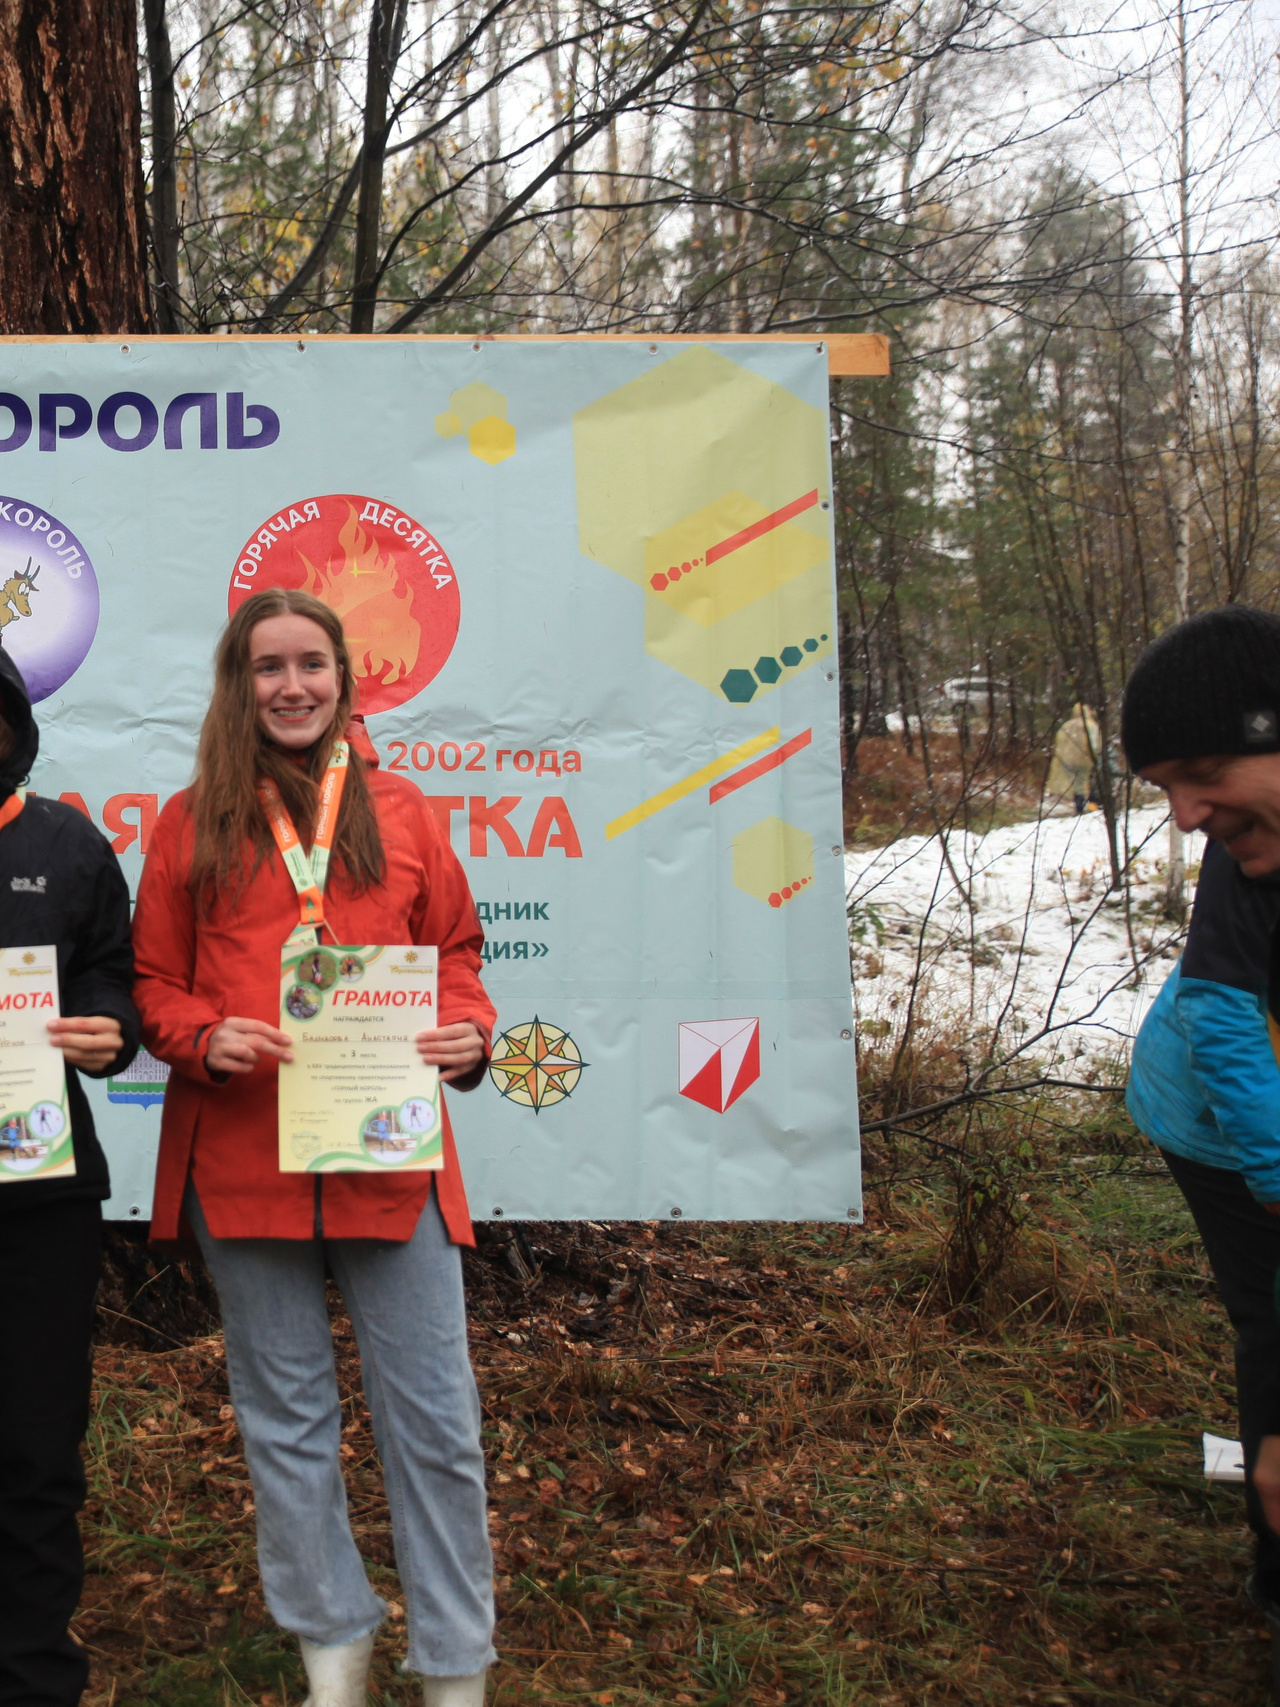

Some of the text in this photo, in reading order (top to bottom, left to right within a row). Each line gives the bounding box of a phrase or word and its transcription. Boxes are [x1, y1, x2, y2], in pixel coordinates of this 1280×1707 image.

[233, 501, 453, 590] ГОРЯЧАЯ ДЕСЯТКА
[387, 741, 582, 777] 2002 года
[332, 990, 433, 1007] ГРАМОТА
[333, 1015, 384, 1023] НАГРАЖДАЕТСЯ
